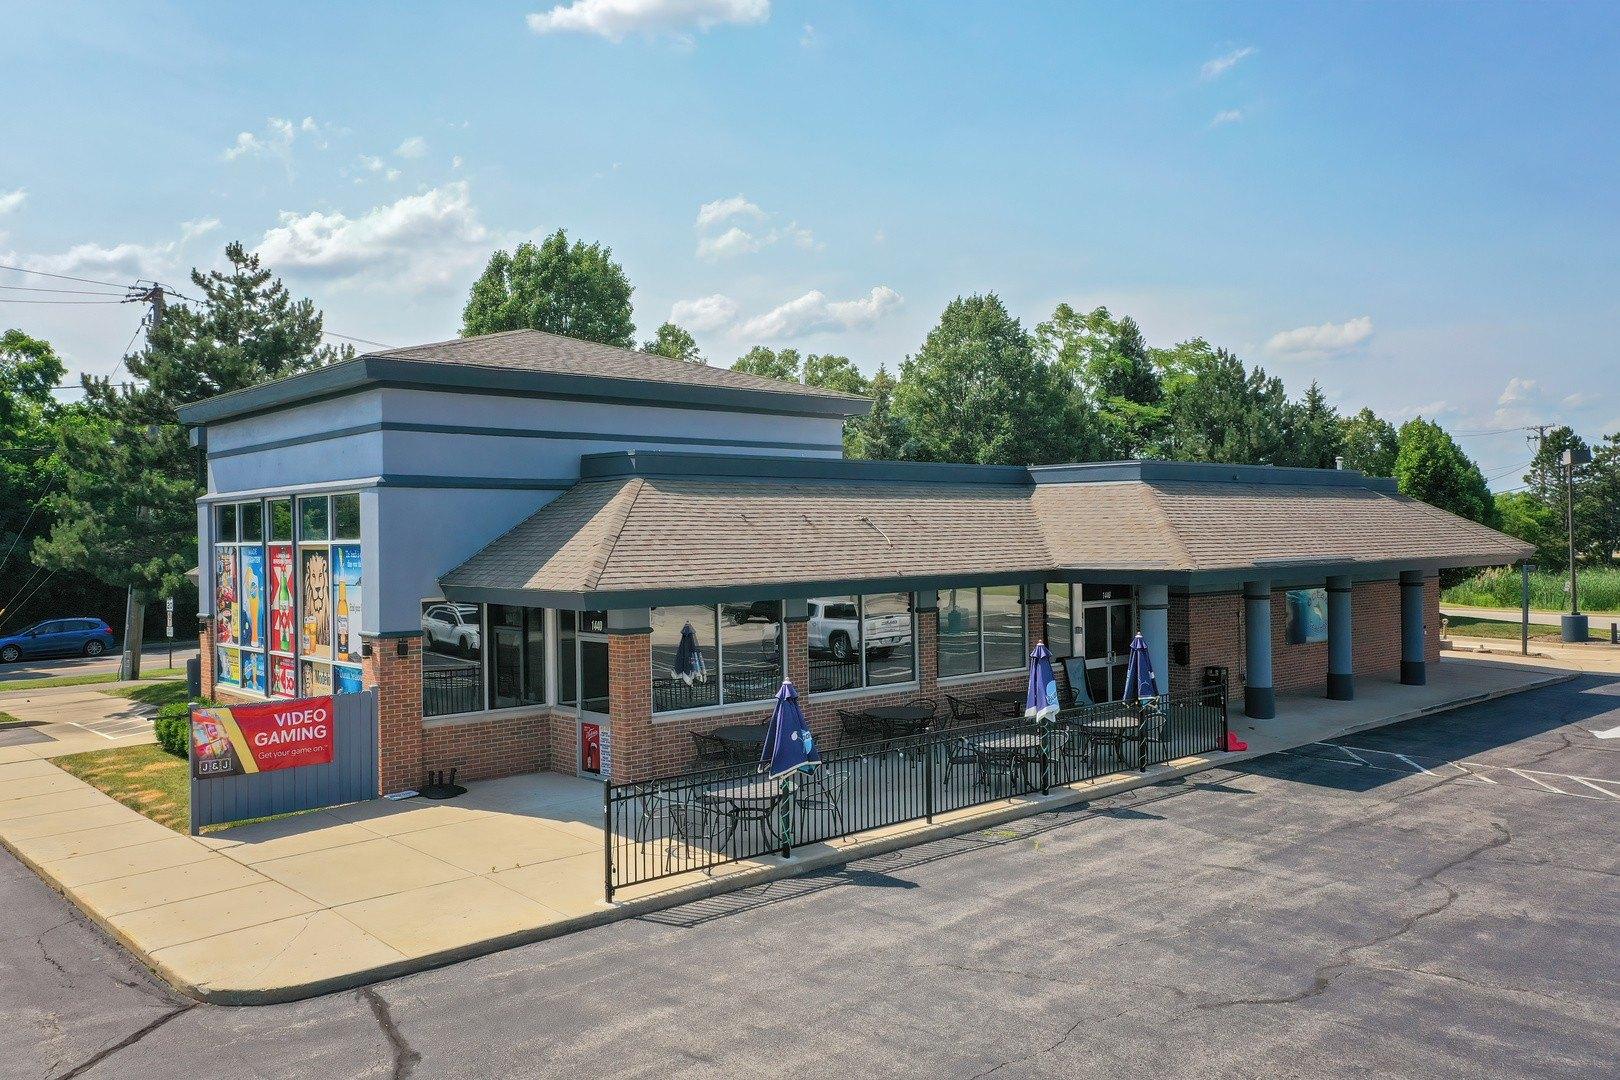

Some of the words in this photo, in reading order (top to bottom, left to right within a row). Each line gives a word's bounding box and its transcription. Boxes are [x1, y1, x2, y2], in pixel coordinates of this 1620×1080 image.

[273, 708, 327, 727] VIDEO
[254, 725, 327, 747] GAMING
[258, 751, 272, 760] Get
[272, 750, 290, 759] your
[291, 746, 312, 757] game
